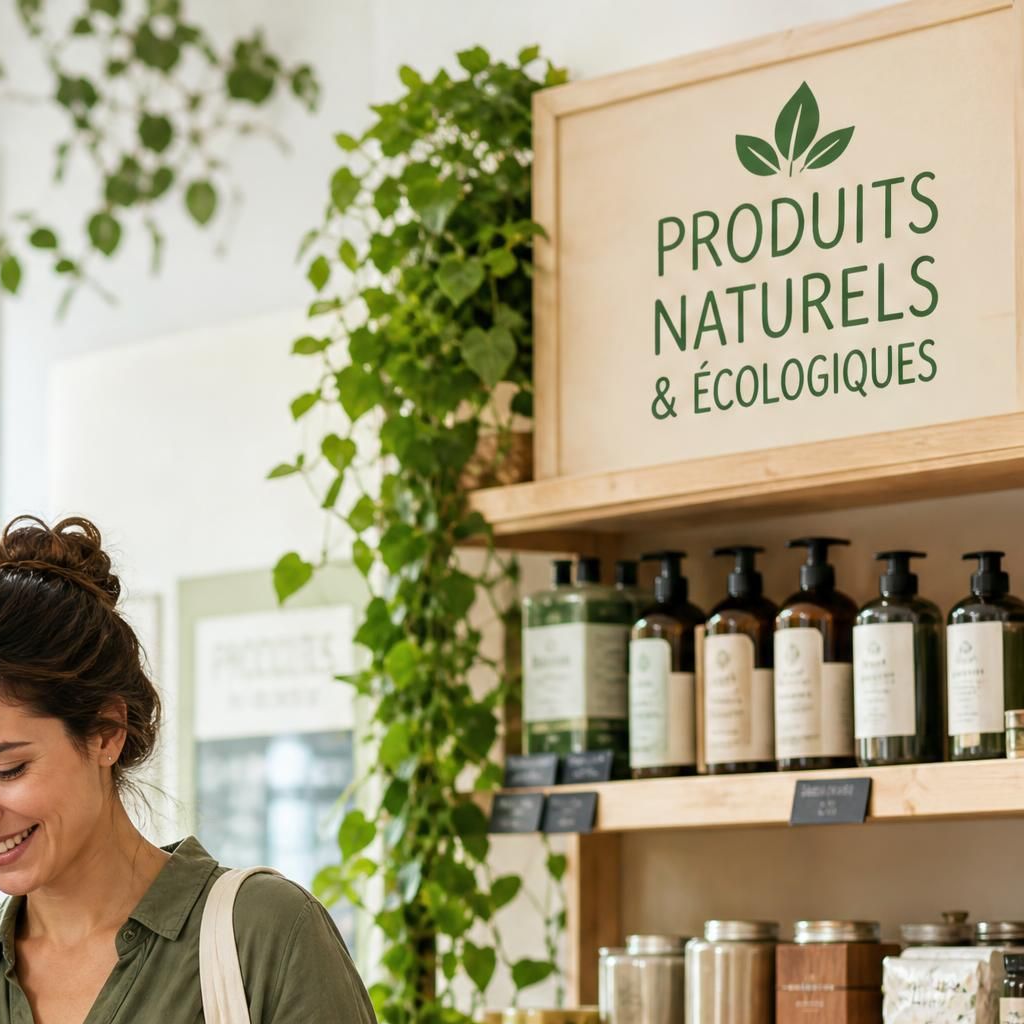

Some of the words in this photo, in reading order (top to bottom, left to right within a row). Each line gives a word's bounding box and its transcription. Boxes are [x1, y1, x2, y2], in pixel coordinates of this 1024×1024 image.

[657, 170, 939, 278] PRODUITS
[654, 254, 939, 356] NATURELS
[651, 376, 678, 421] &
[693, 338, 938, 415] ÉCOLOGIQUES
